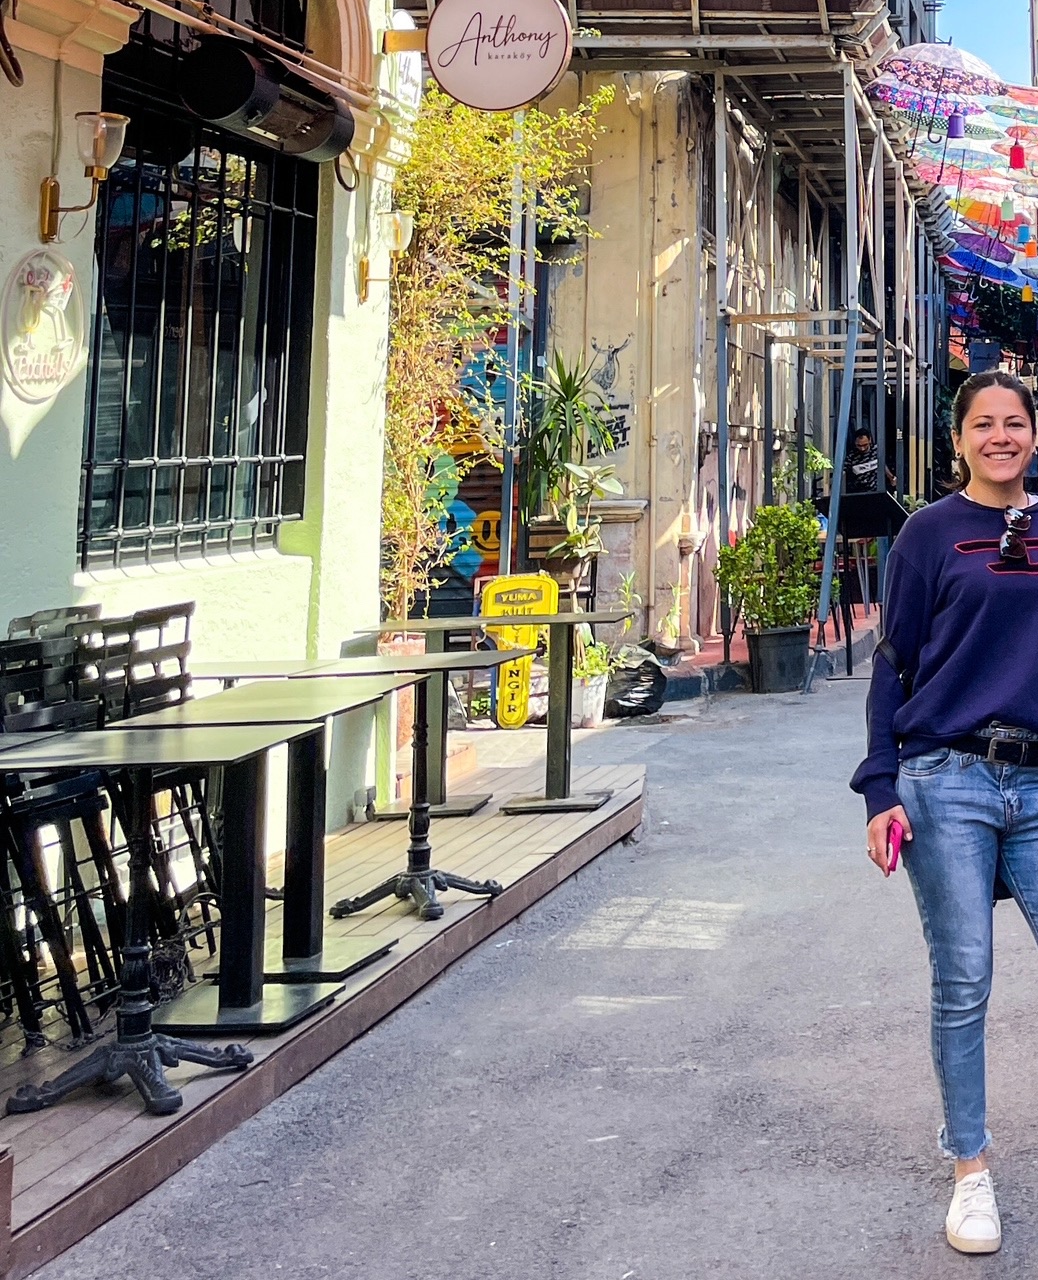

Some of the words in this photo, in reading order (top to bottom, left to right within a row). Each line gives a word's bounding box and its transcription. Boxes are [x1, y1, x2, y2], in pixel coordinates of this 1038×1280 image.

[438, 12, 557, 67] Anthony
[488, 52, 532, 60] karaköy
[501, 592, 537, 603] YUMA
